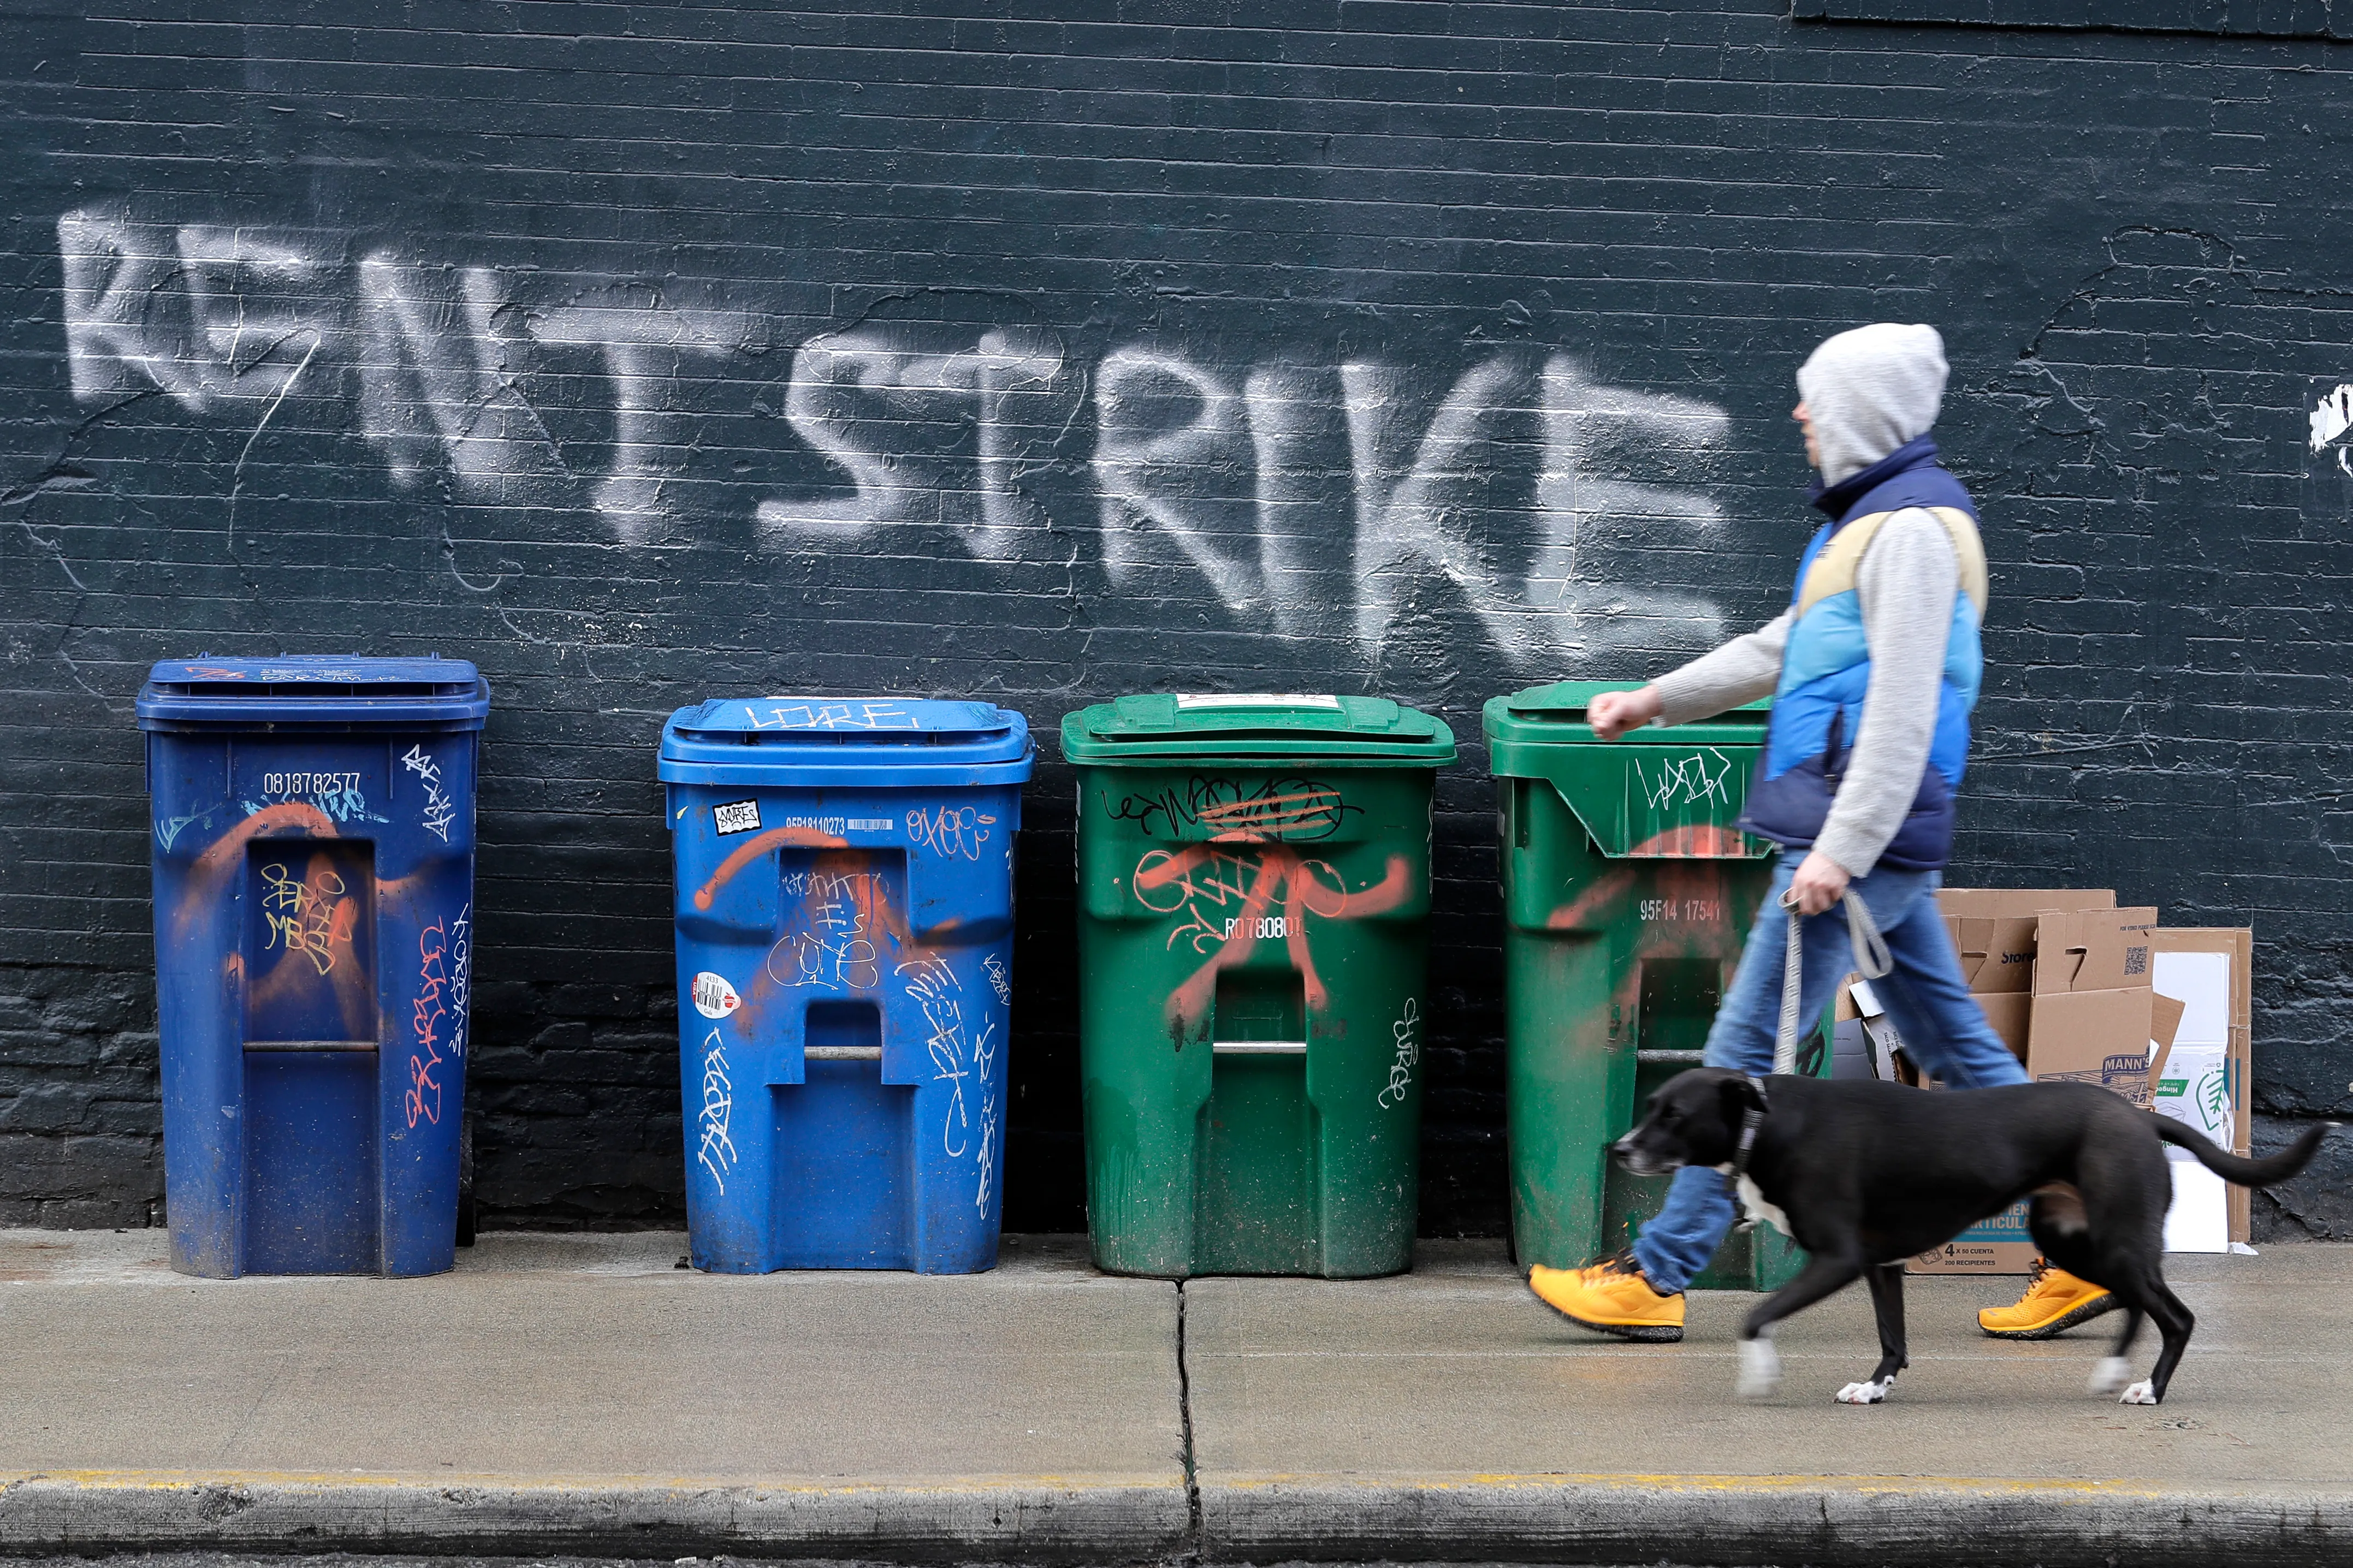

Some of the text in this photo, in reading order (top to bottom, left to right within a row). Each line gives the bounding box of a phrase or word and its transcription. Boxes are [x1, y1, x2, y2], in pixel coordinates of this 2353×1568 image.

[57, 205, 1731, 667] RENT STRIKE
[264, 773, 360, 793] 0818782577
[1640, 899, 1720, 920] 95F14 17541
[706, 975, 719, 984] 4133
[1945, 1244, 1955, 1256] 4
